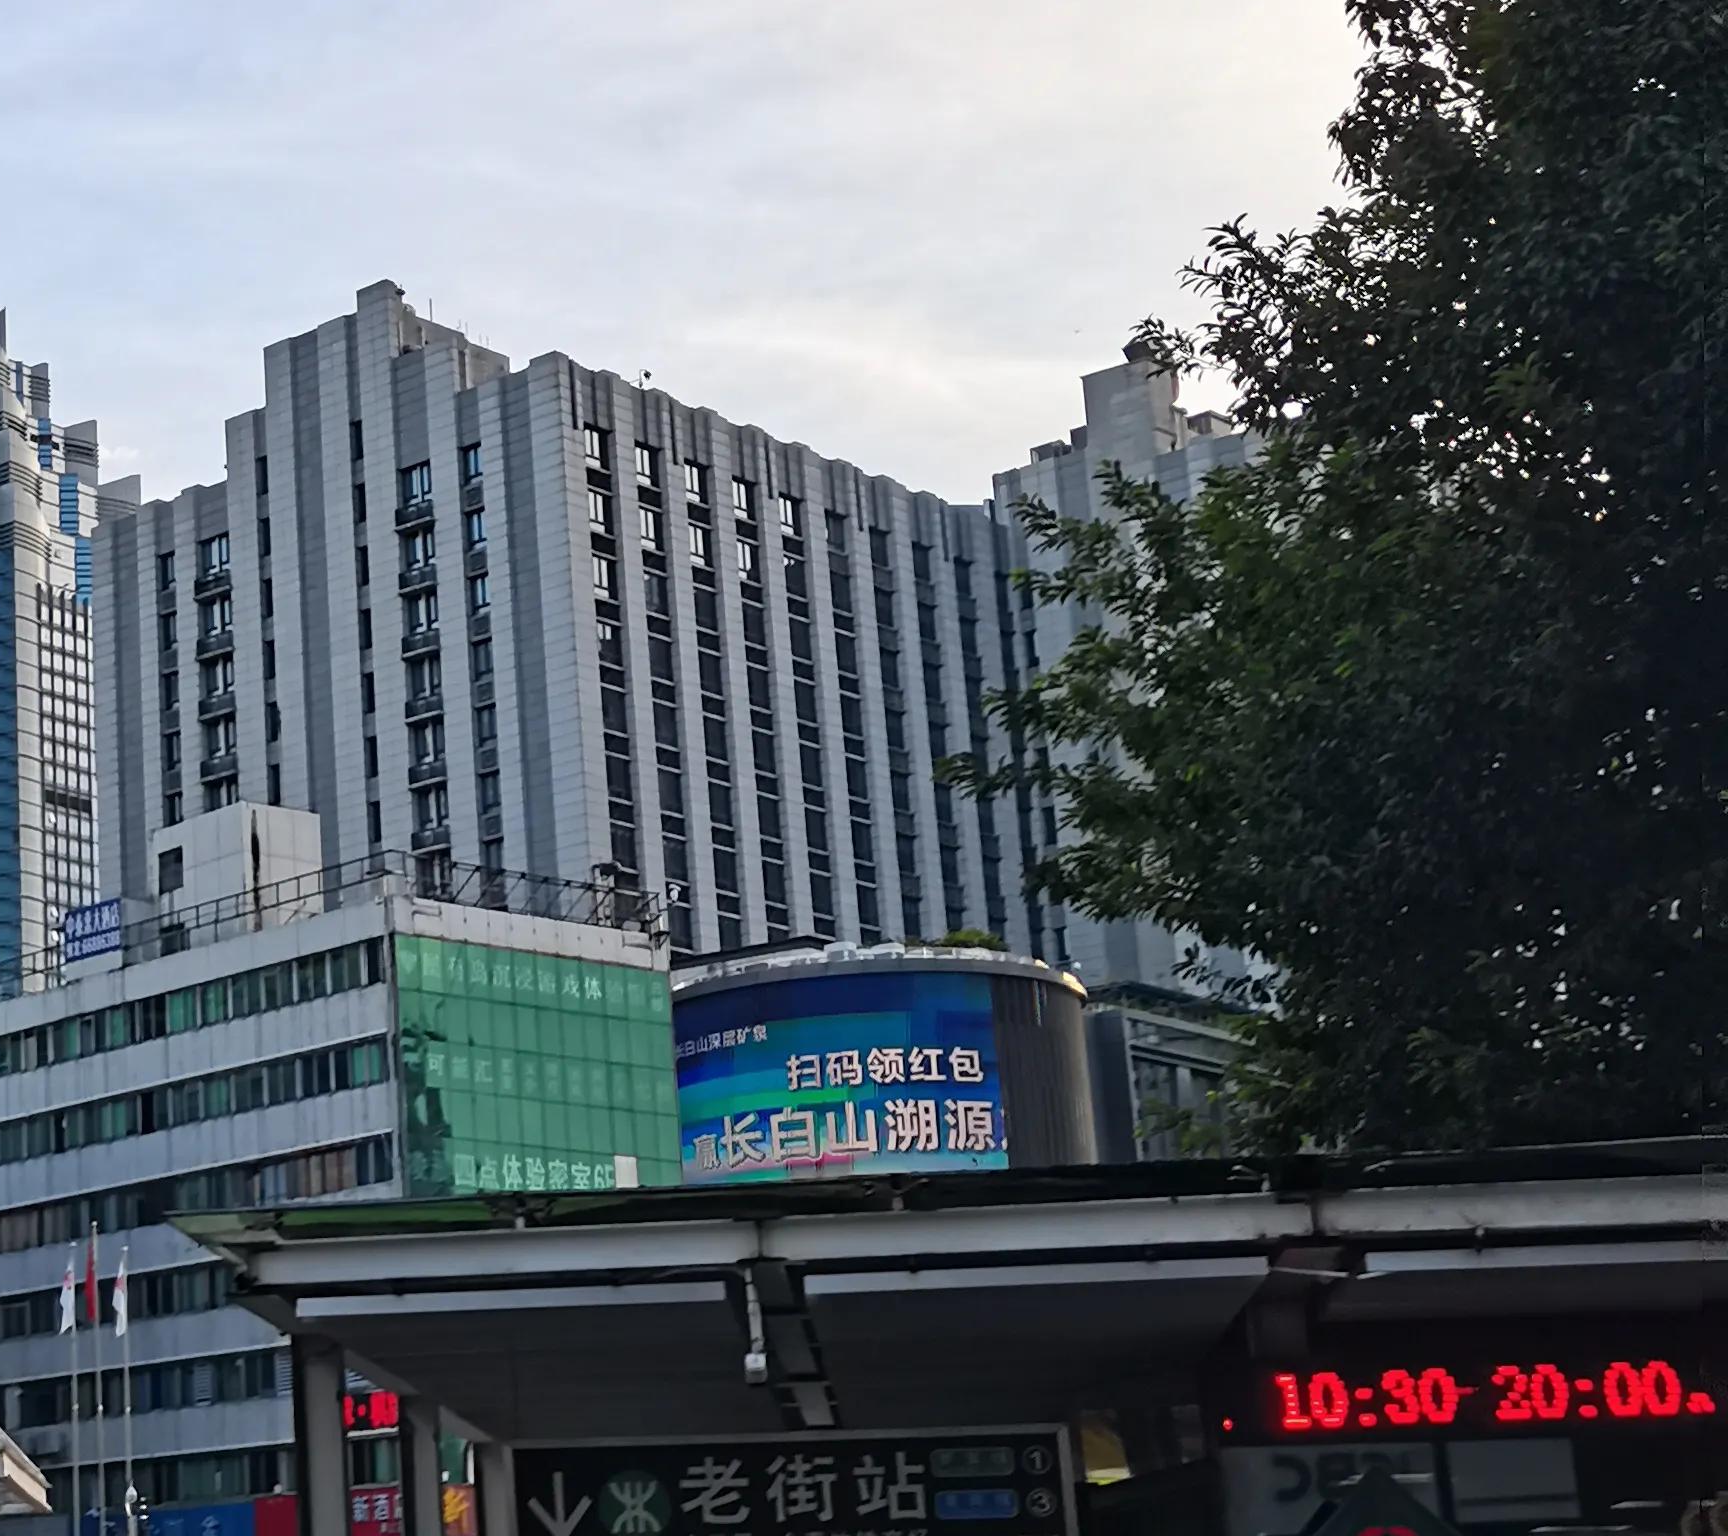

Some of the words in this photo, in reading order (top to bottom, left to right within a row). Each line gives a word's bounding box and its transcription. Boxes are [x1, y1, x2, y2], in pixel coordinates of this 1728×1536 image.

[786, 1045, 985, 1091] 扫码领红包
[694, 1098, 1010, 1170] 赢长白山溯源
[679, 1450, 928, 1526] 老街站
